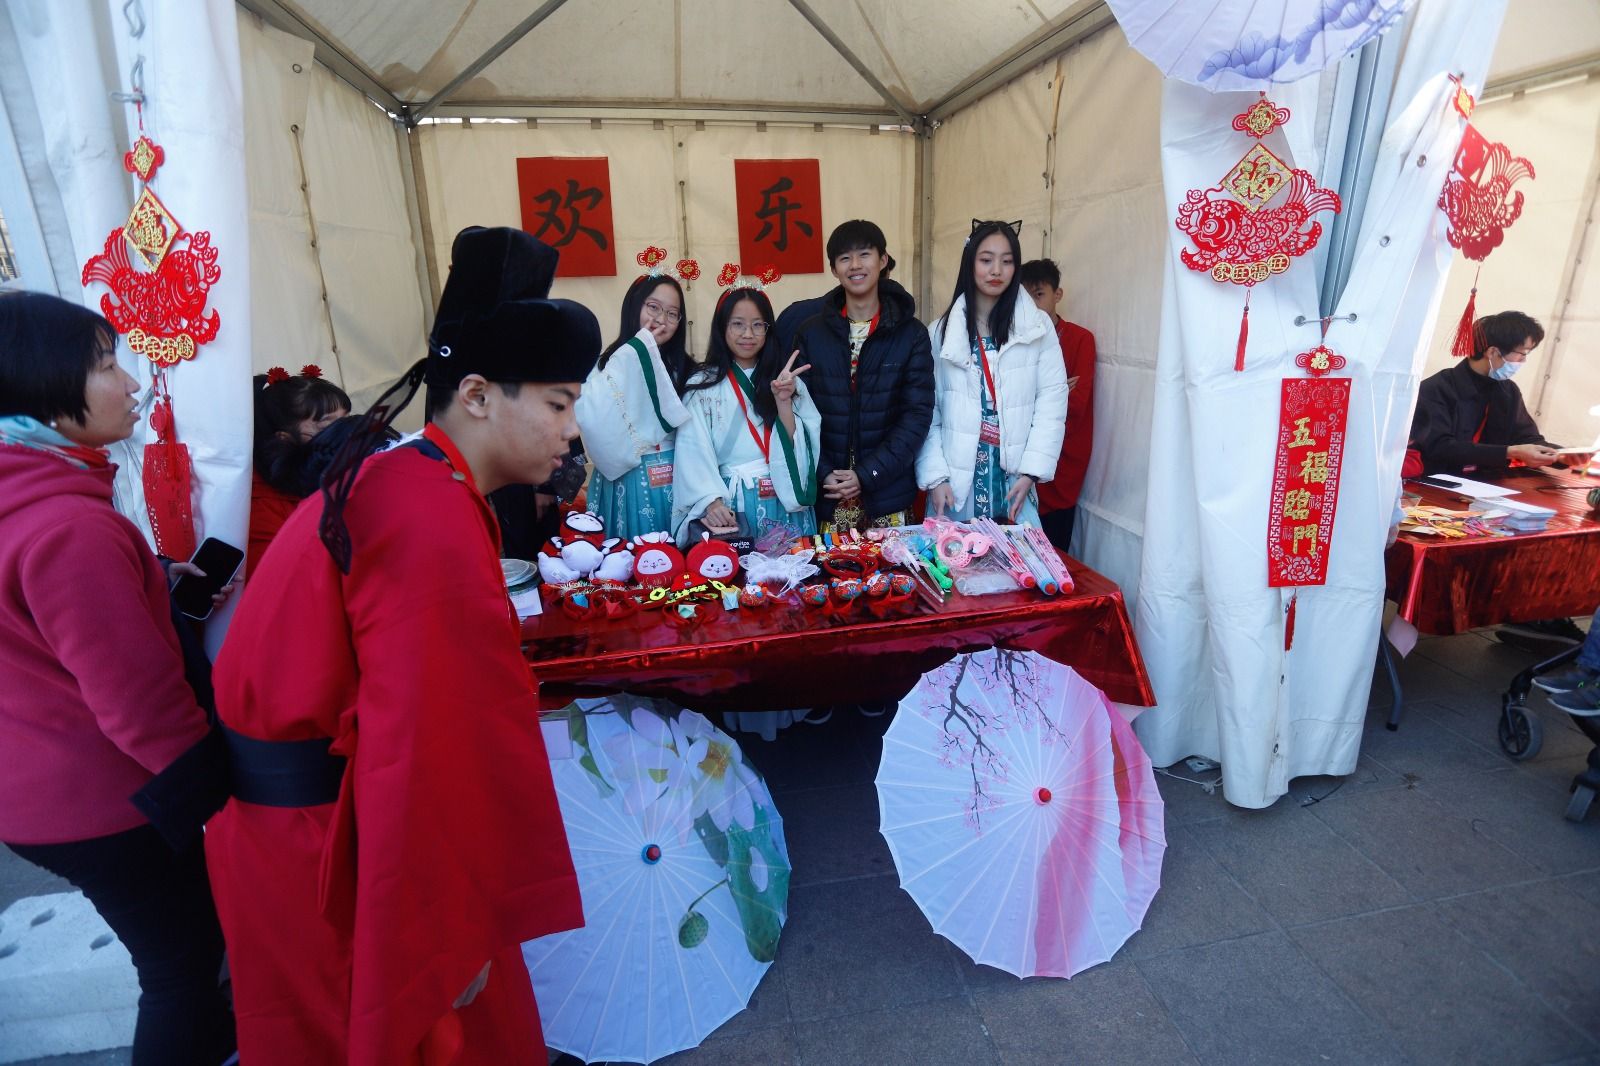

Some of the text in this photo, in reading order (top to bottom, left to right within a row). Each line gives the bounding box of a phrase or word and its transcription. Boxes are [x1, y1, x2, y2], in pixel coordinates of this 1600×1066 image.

[533, 178, 608, 252] 欢
[753, 176, 813, 252] 乐
[1283, 416, 1329, 557] 五福臨門
